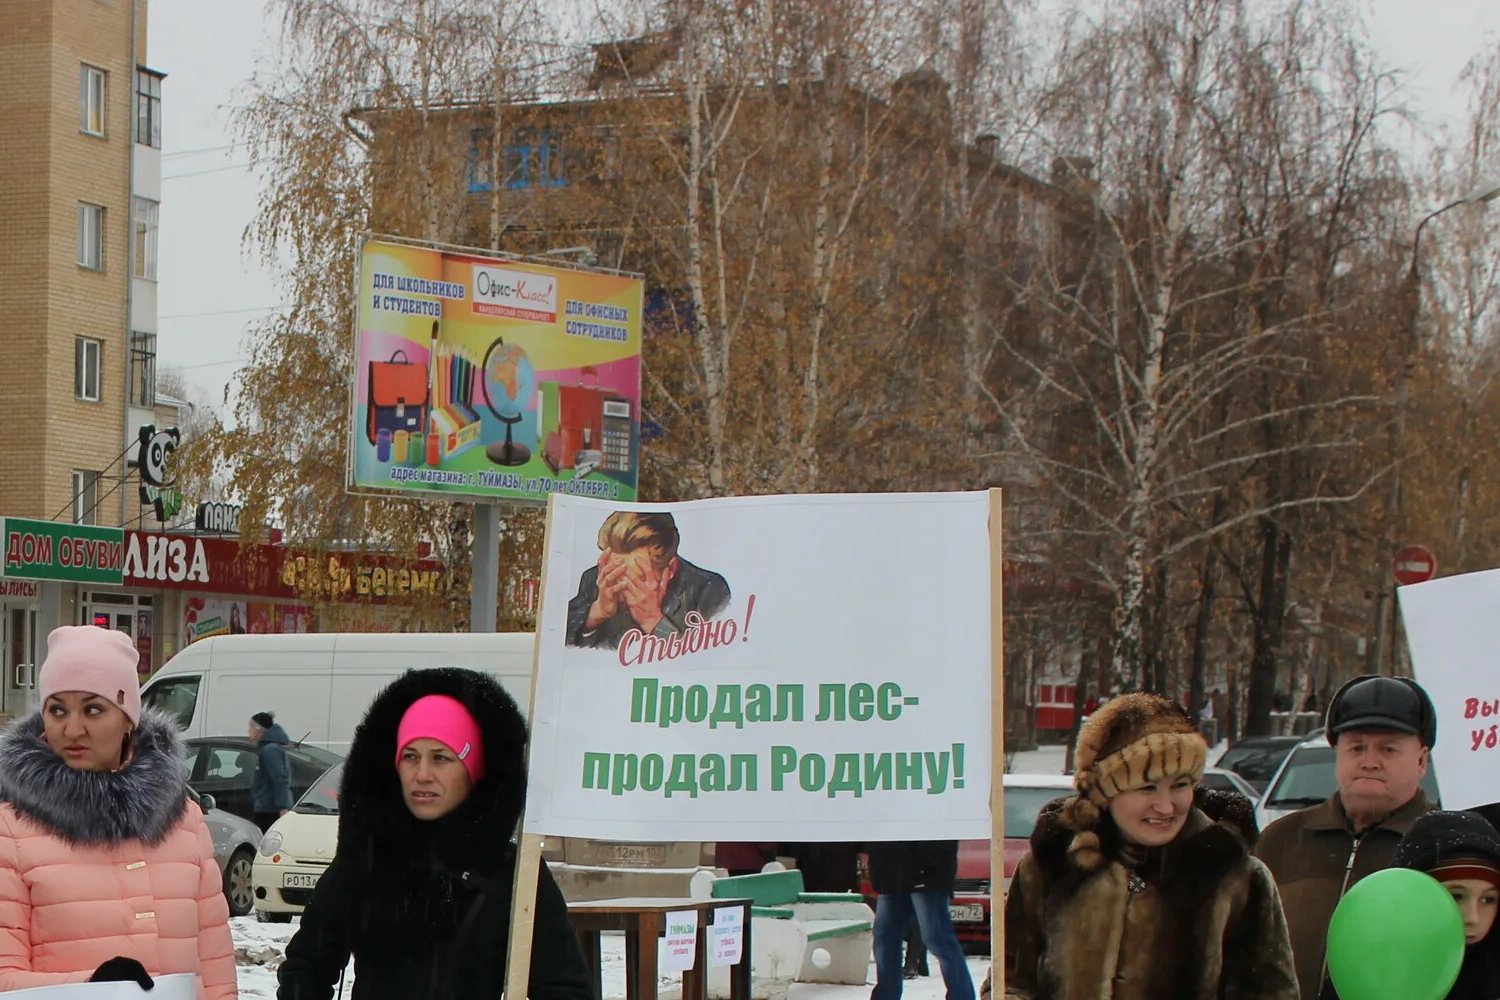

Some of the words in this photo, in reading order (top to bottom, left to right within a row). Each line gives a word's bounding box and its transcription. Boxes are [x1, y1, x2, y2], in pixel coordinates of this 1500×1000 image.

[373, 274, 394, 290] ДЛЯ
[397, 276, 464, 299] ШКОЛЬНИКОВ
[373, 295, 381, 308] И
[383, 296, 441, 316] СТУДЕНТОВ
[565, 301, 583, 316] ДЛЯ
[586, 303, 628, 320] ОФИСНЫХ
[566, 321, 627, 341] СОТРУДНИКОВ
[391, 466, 418, 482] адрес
[420, 469, 466, 483] магазина:
[6, 532, 52, 568] ДОМ
[58, 537, 121, 571] ОБУВИ
[123, 533, 210, 582] ЛИЗА
[618, 594, 756, 666] Стыдно!
[630, 678, 804, 728] Продал
[814, 681, 920, 722] лес-
[581, 751, 758, 798] продал
[770, 743, 965, 798] Родину!
